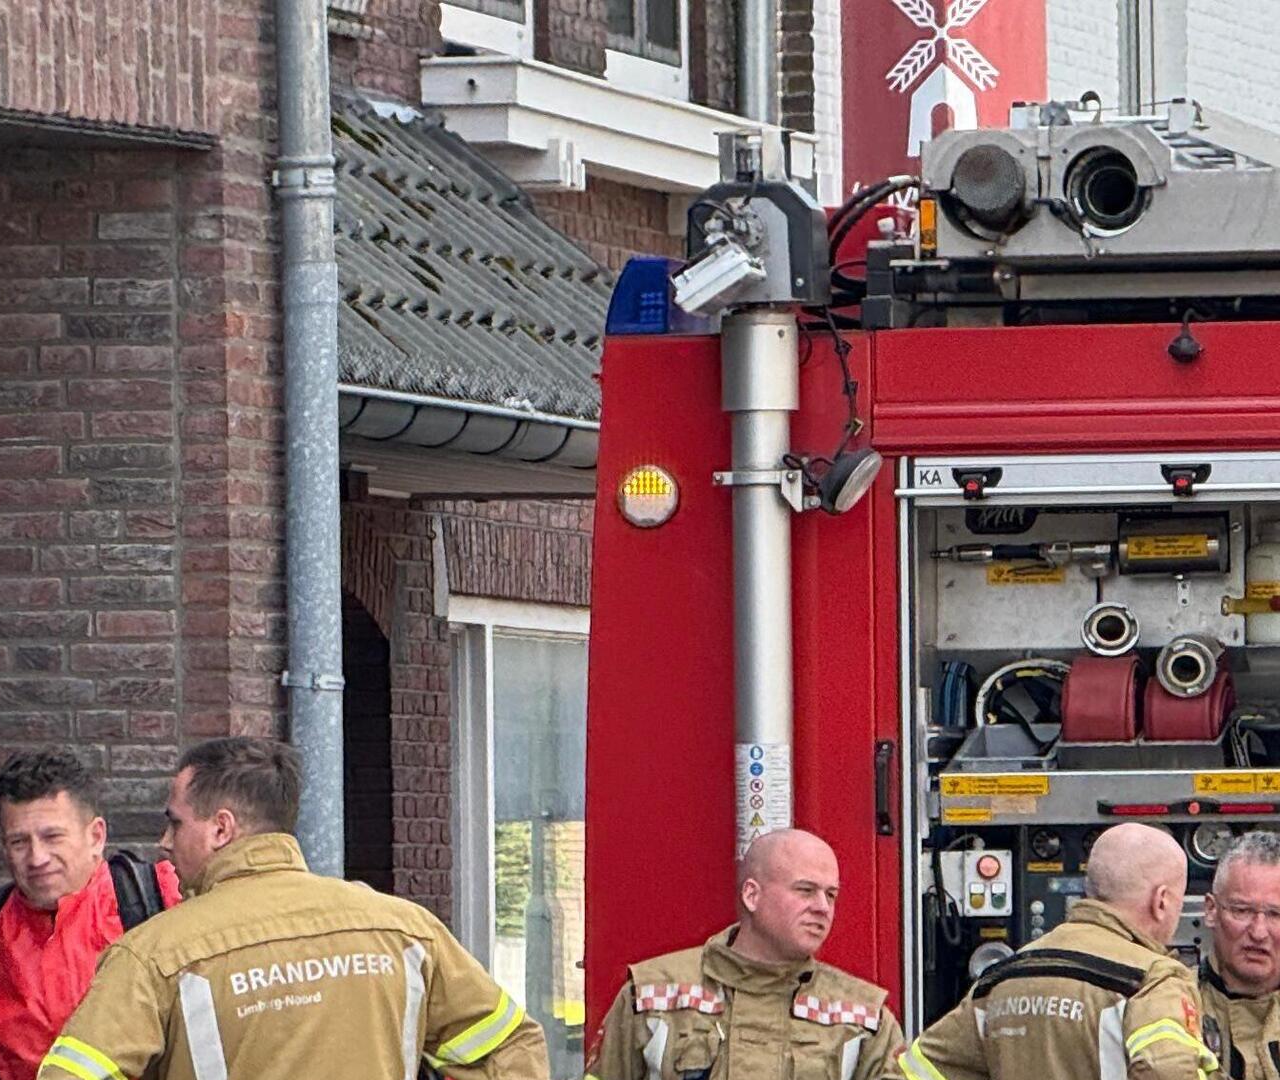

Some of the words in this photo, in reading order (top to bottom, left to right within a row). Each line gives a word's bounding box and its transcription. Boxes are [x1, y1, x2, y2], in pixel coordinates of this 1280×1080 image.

[919, 470, 942, 485] KA
[229, 952, 395, 996] BRANDWEER
[235, 990, 323, 1019] Limbg-Noord
